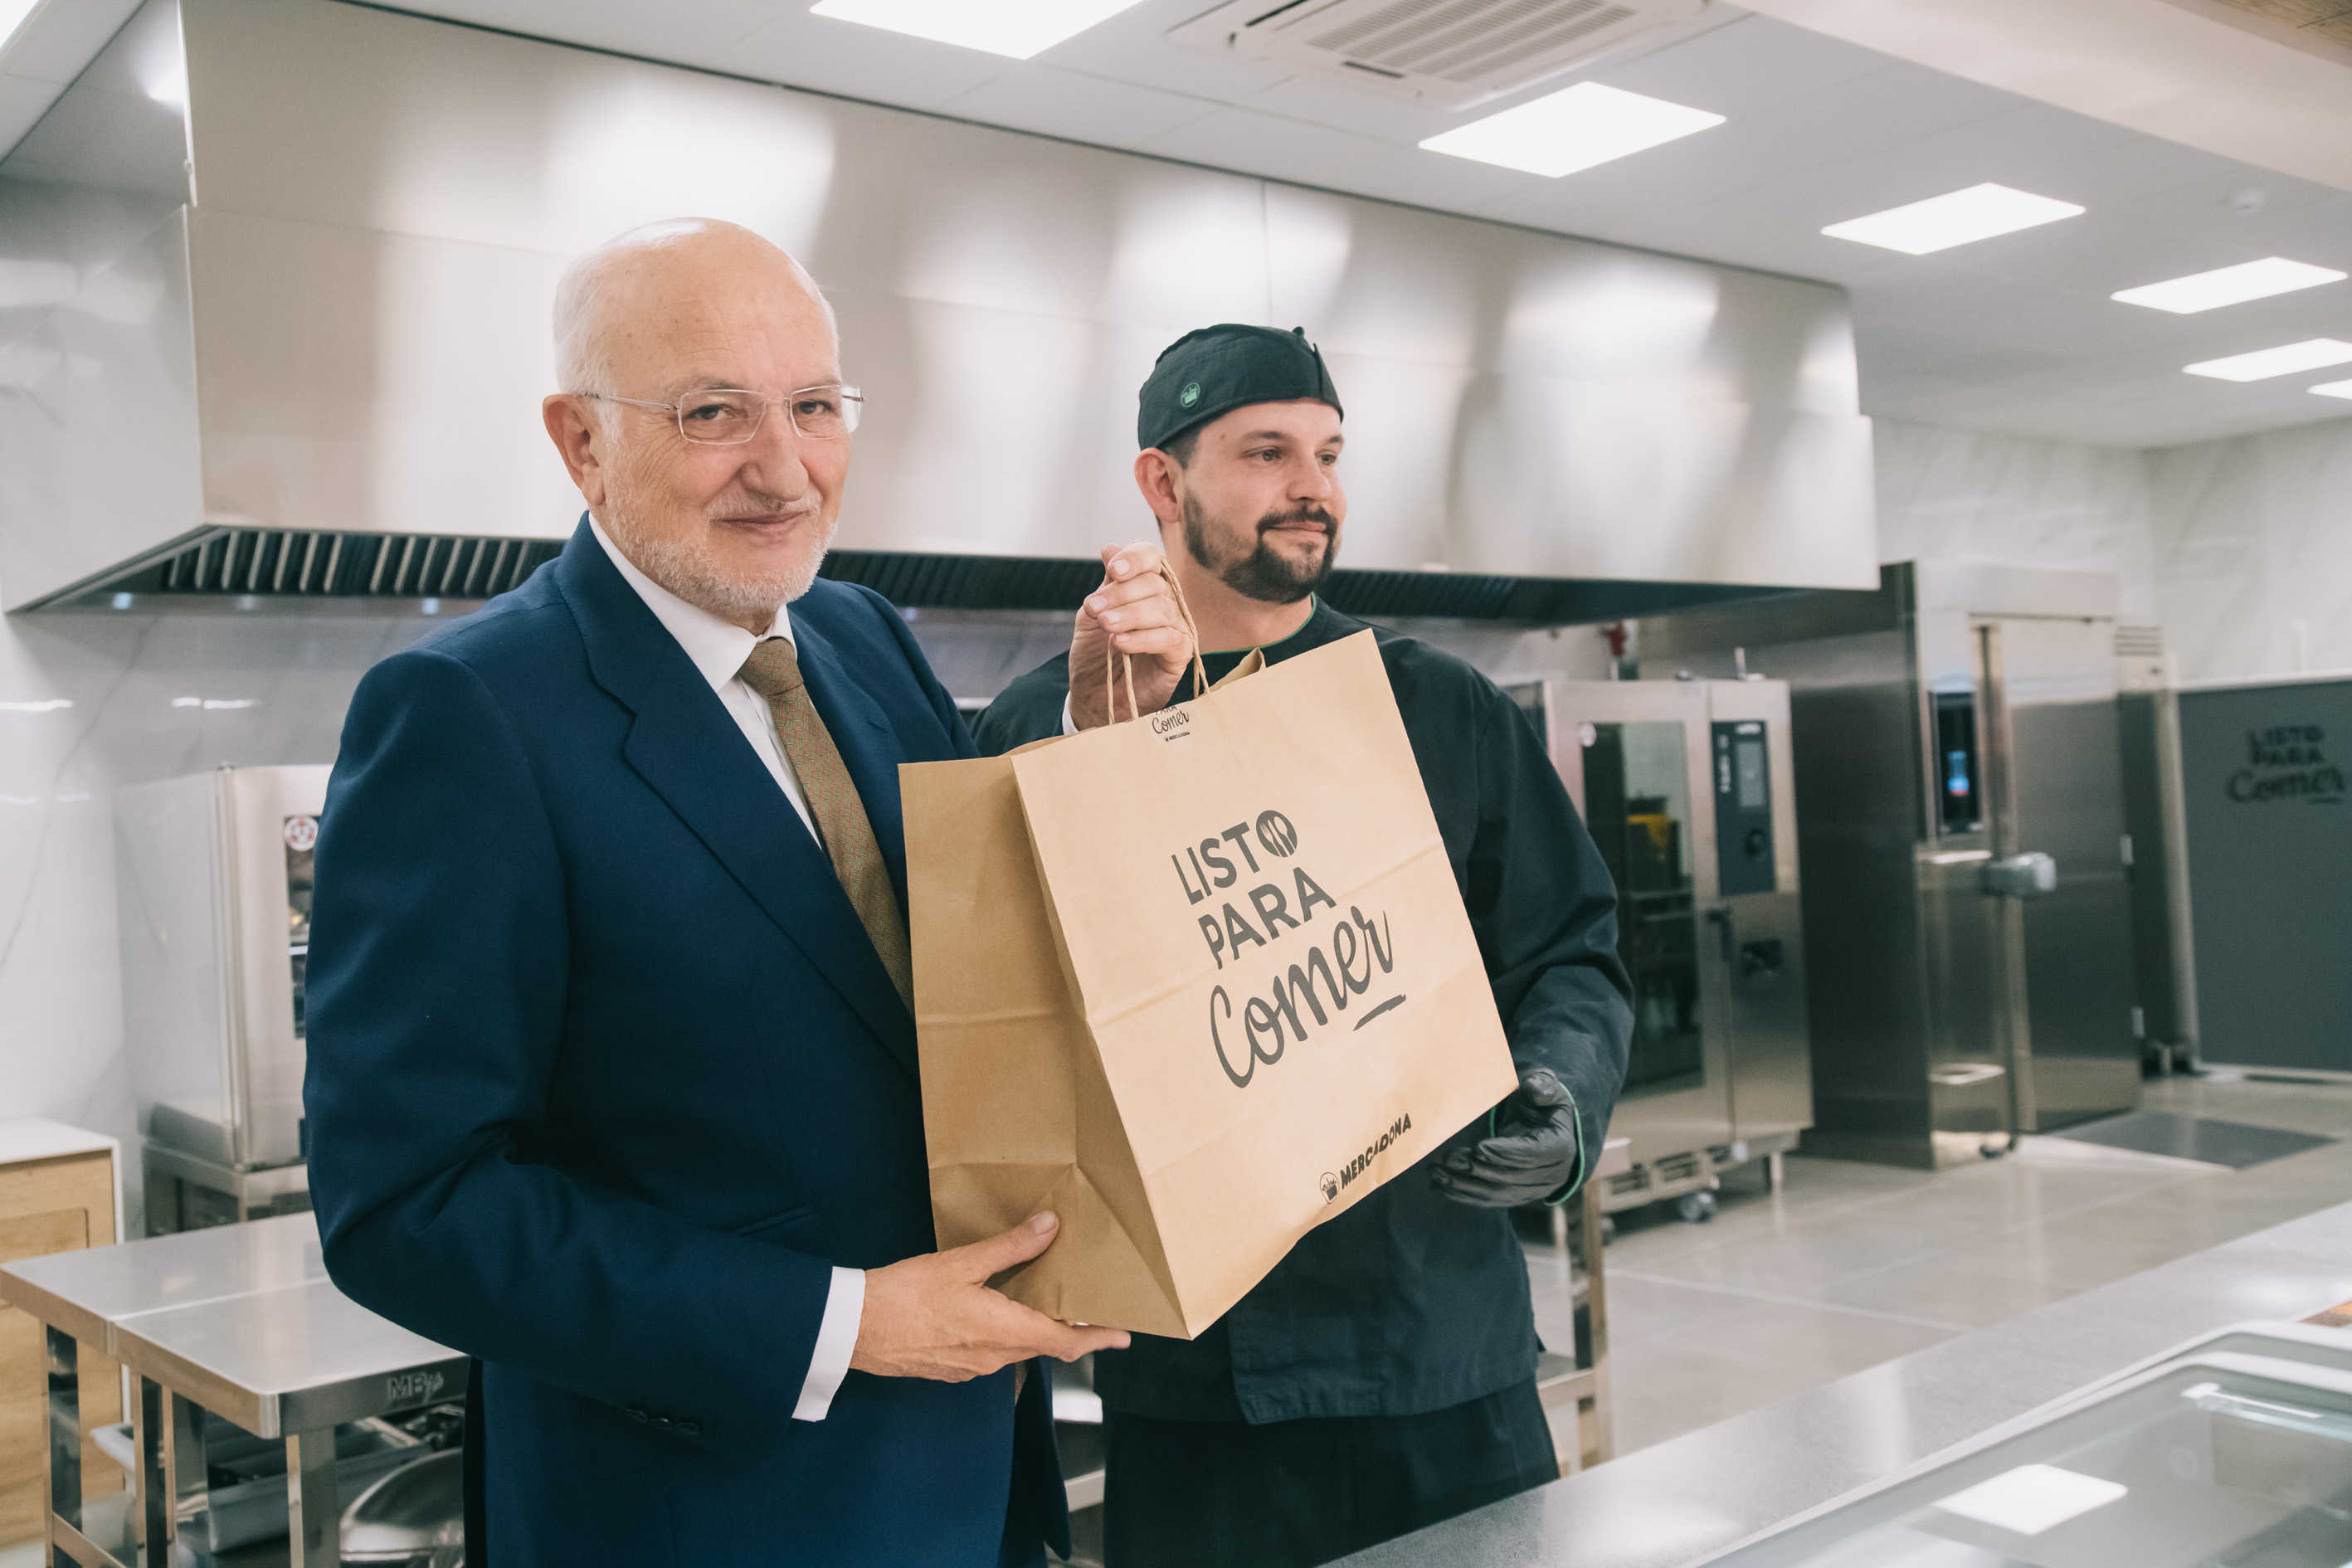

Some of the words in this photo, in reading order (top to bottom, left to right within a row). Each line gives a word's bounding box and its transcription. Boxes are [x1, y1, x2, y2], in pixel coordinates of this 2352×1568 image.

[1152, 710, 1190, 734] Comer
[1198, 867, 1337, 970] PARA
[1210, 905, 1393, 1088] Comer
[1340, 1113, 1411, 1190] MERCADONA
